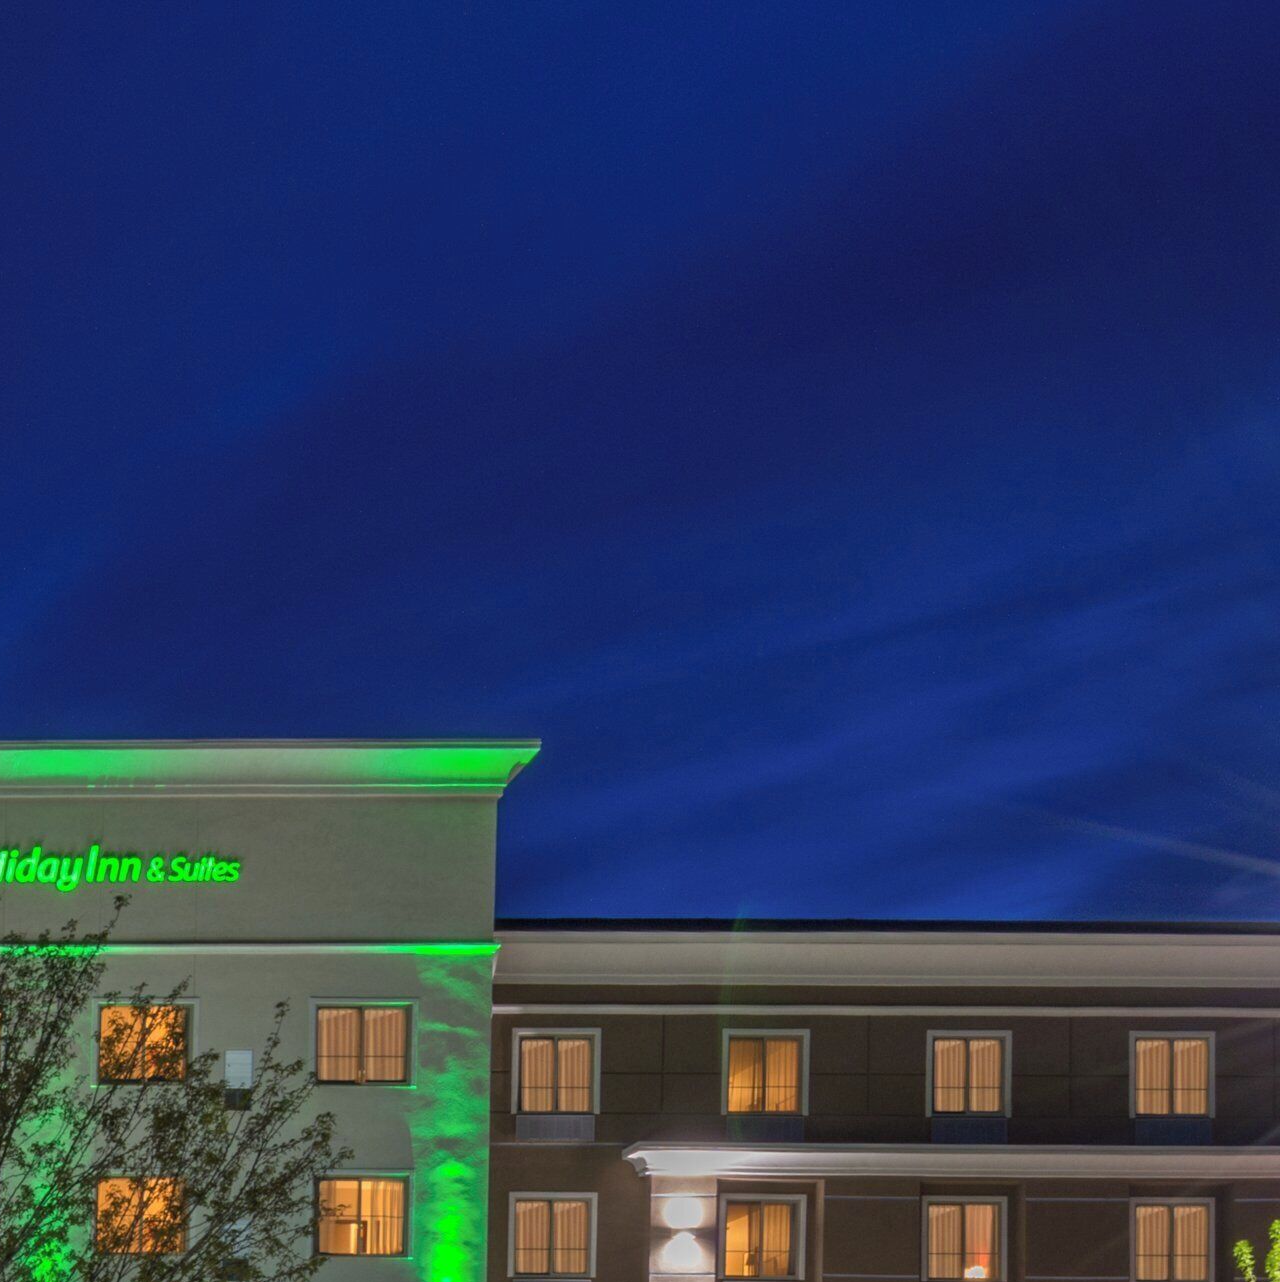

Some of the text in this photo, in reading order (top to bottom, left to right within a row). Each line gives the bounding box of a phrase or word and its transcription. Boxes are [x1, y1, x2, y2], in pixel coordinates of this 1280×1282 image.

[86, 844, 142, 883] Inn
[146, 857, 165, 883] &
[168, 856, 241, 883] Suites
